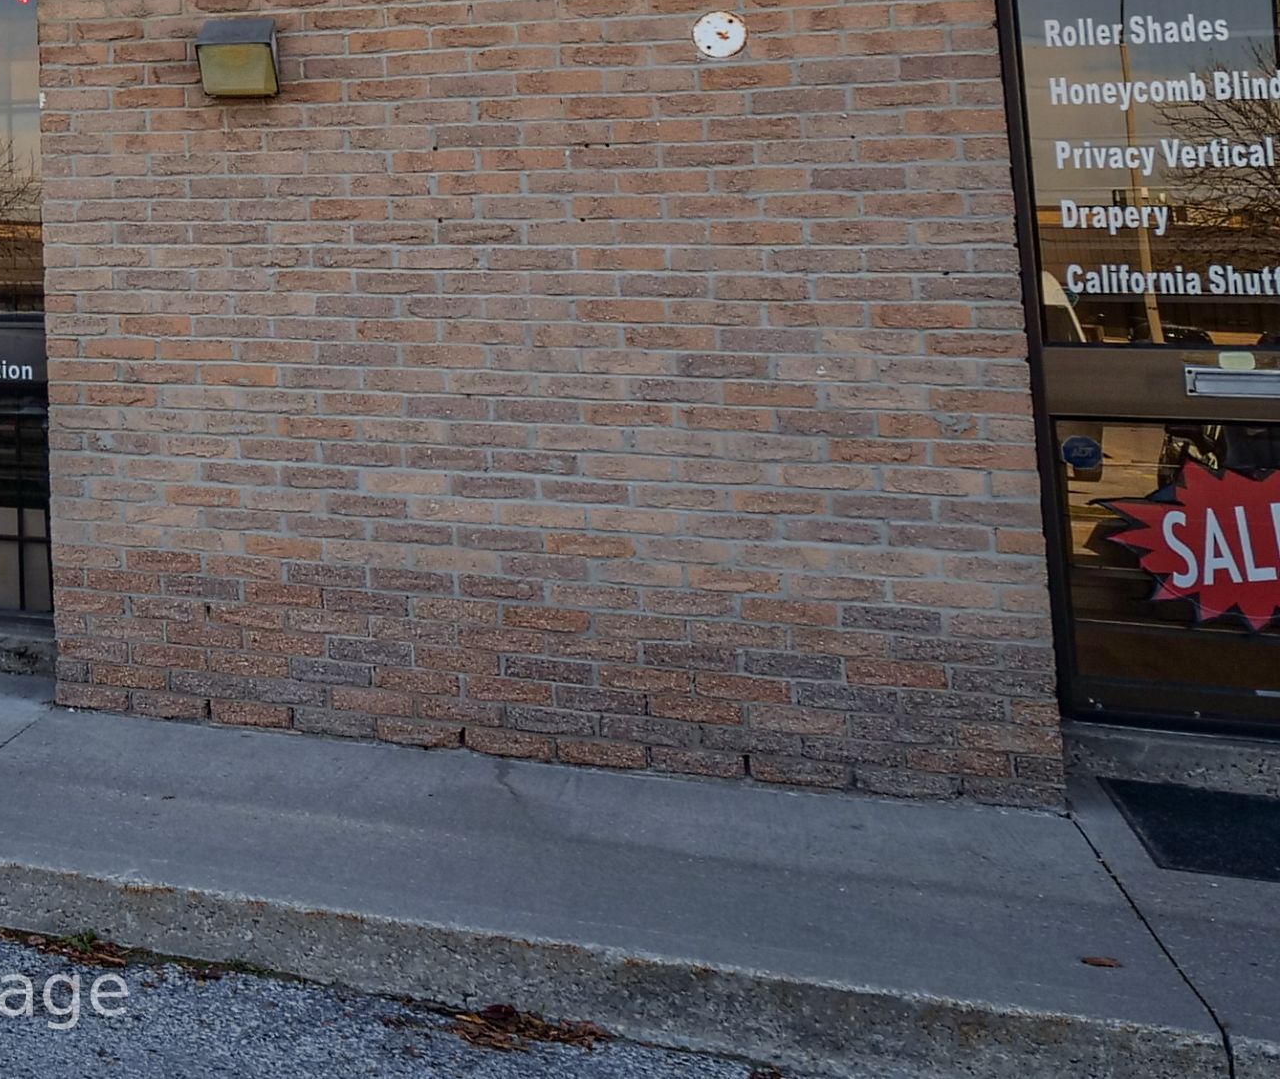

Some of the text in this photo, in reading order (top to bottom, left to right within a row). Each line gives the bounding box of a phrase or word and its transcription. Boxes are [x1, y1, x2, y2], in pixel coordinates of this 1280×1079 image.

[1044, 14, 1229, 47] Roller Shades
[1049, 73, 1206, 111] Honeycomb
[1055, 136, 1275, 176] Privacy Vertical
[1060, 200, 1168, 236] Drapery
[1067, 264, 1202, 295] California
[1162, 502, 1280, 588] SAL
